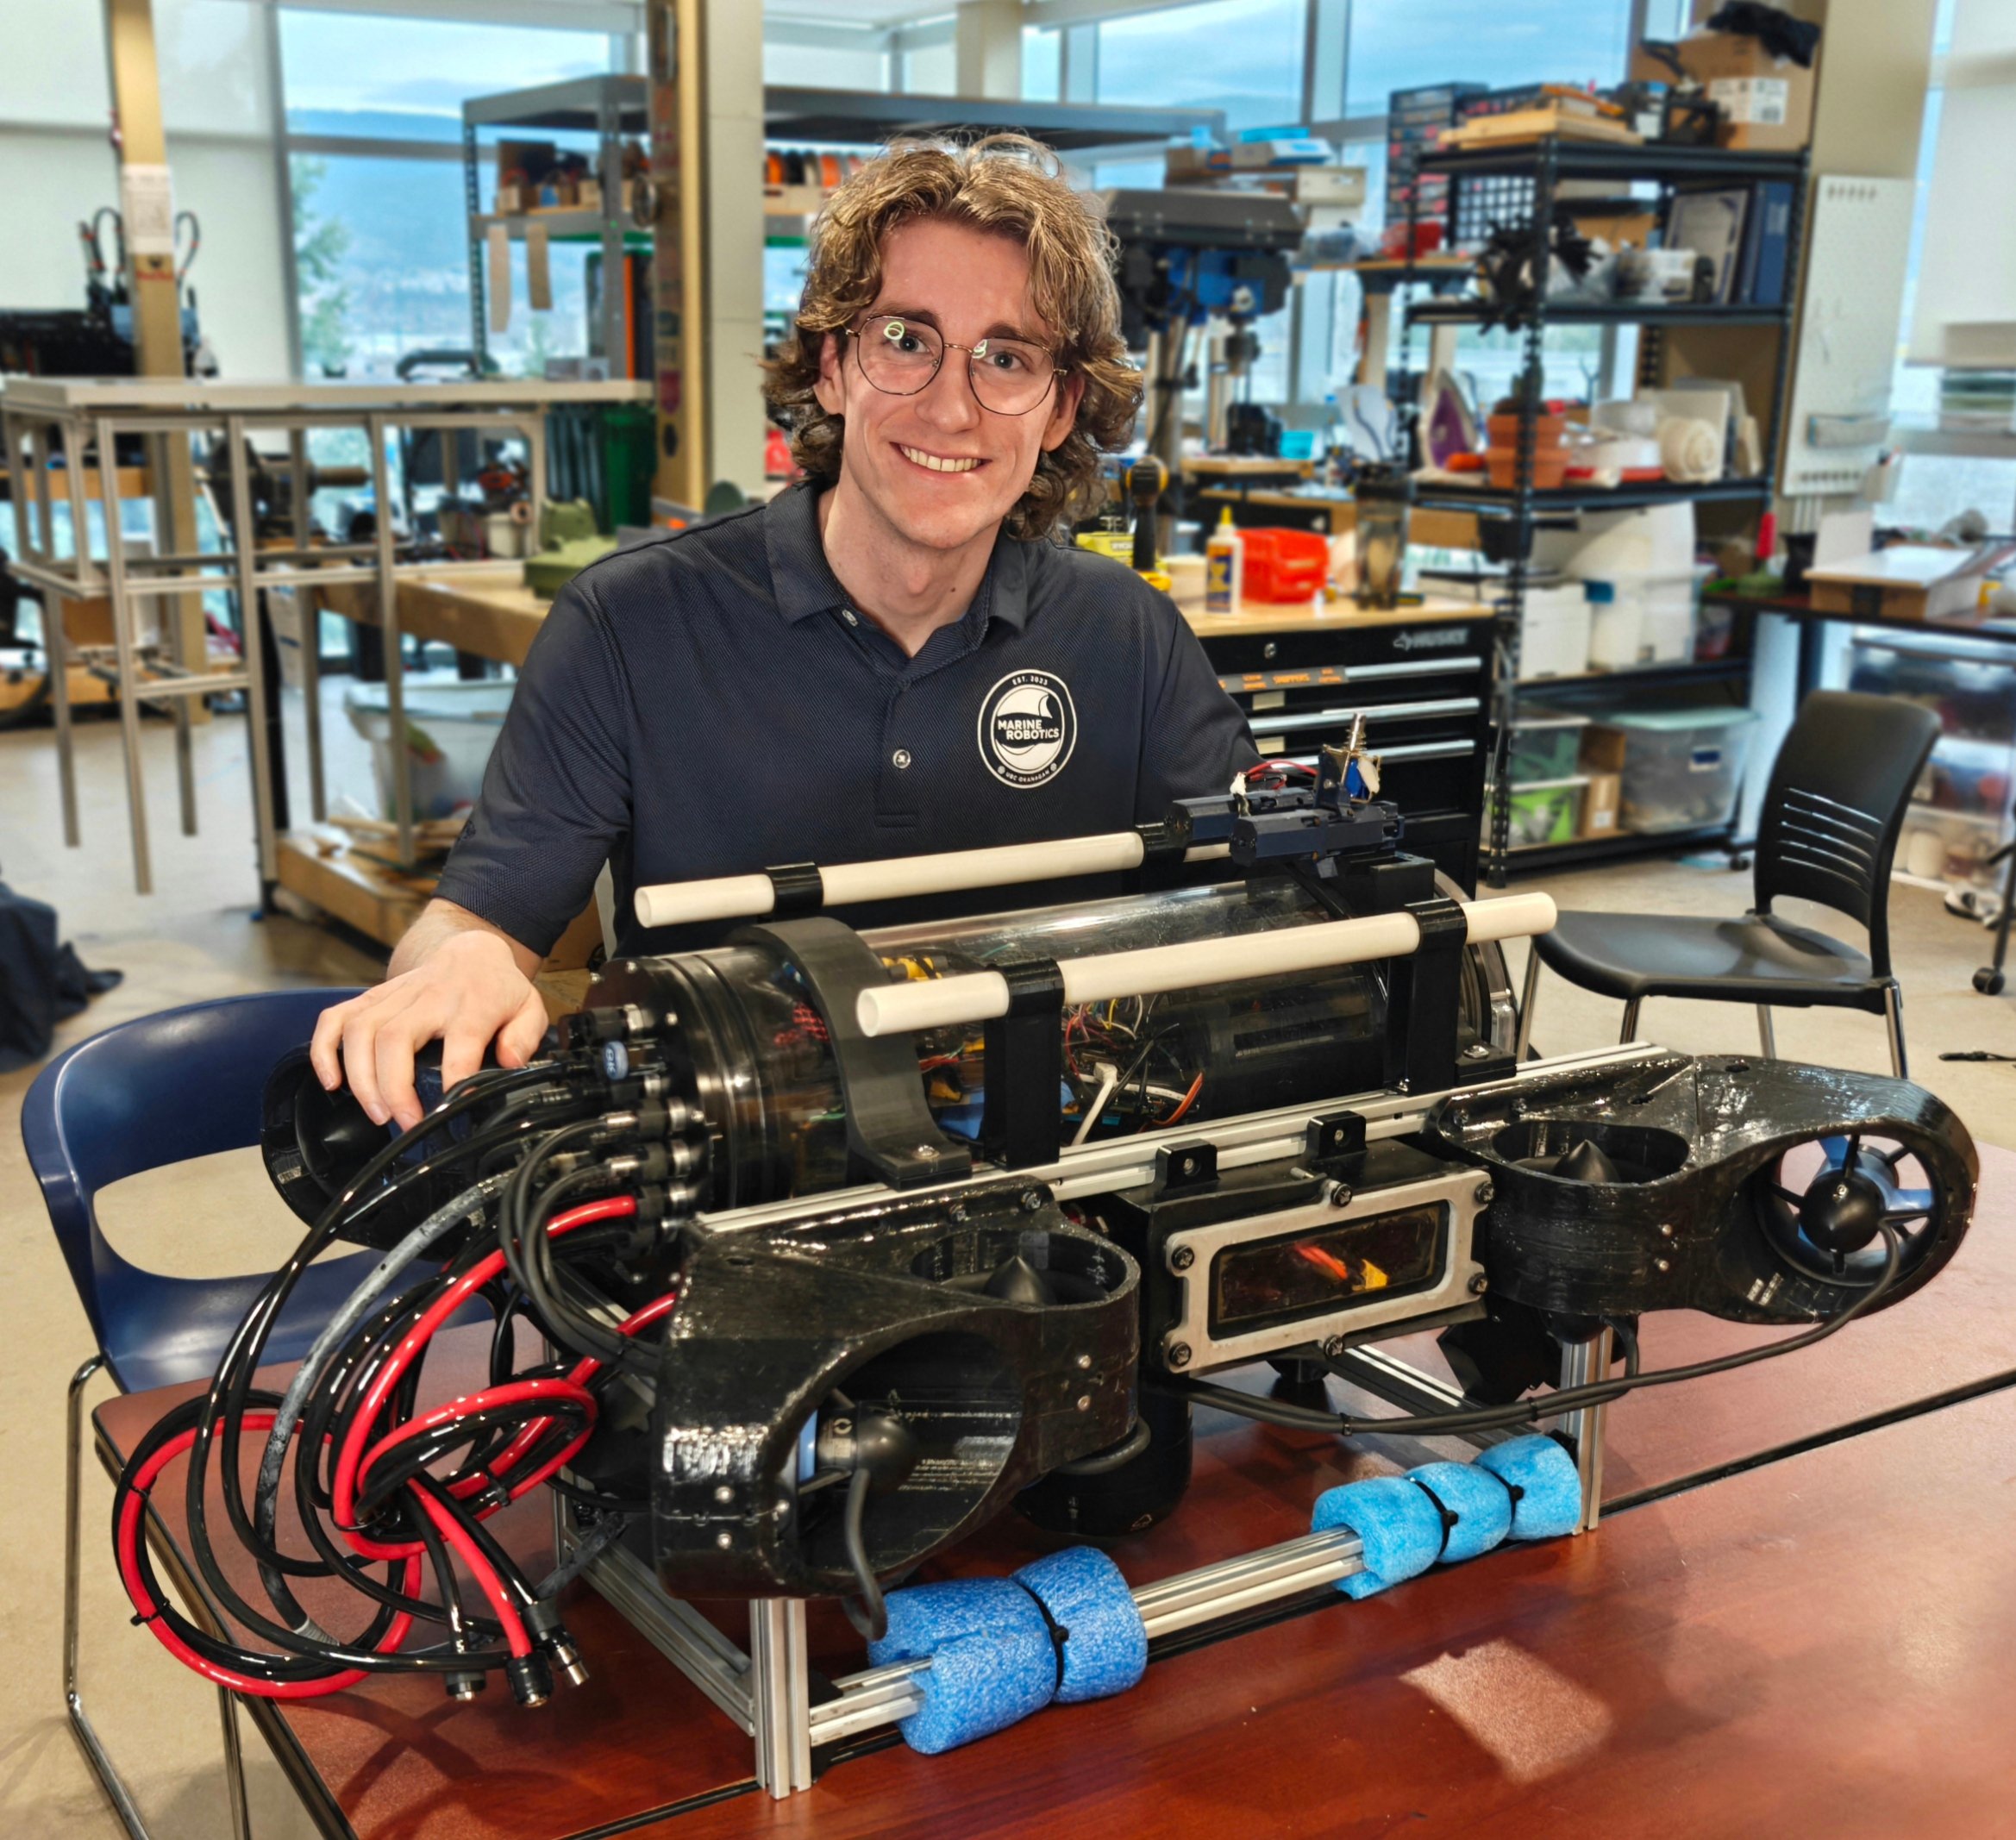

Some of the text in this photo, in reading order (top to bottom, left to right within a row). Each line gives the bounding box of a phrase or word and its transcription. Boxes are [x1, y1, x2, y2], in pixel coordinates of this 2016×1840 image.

[1030, 675, 1049, 685] 2023
[998, 719, 1042, 730] MARINE
[1006, 728, 1060, 741] ROBOTICS
[1005, 769, 1050, 782] UBC OKANAGAN
